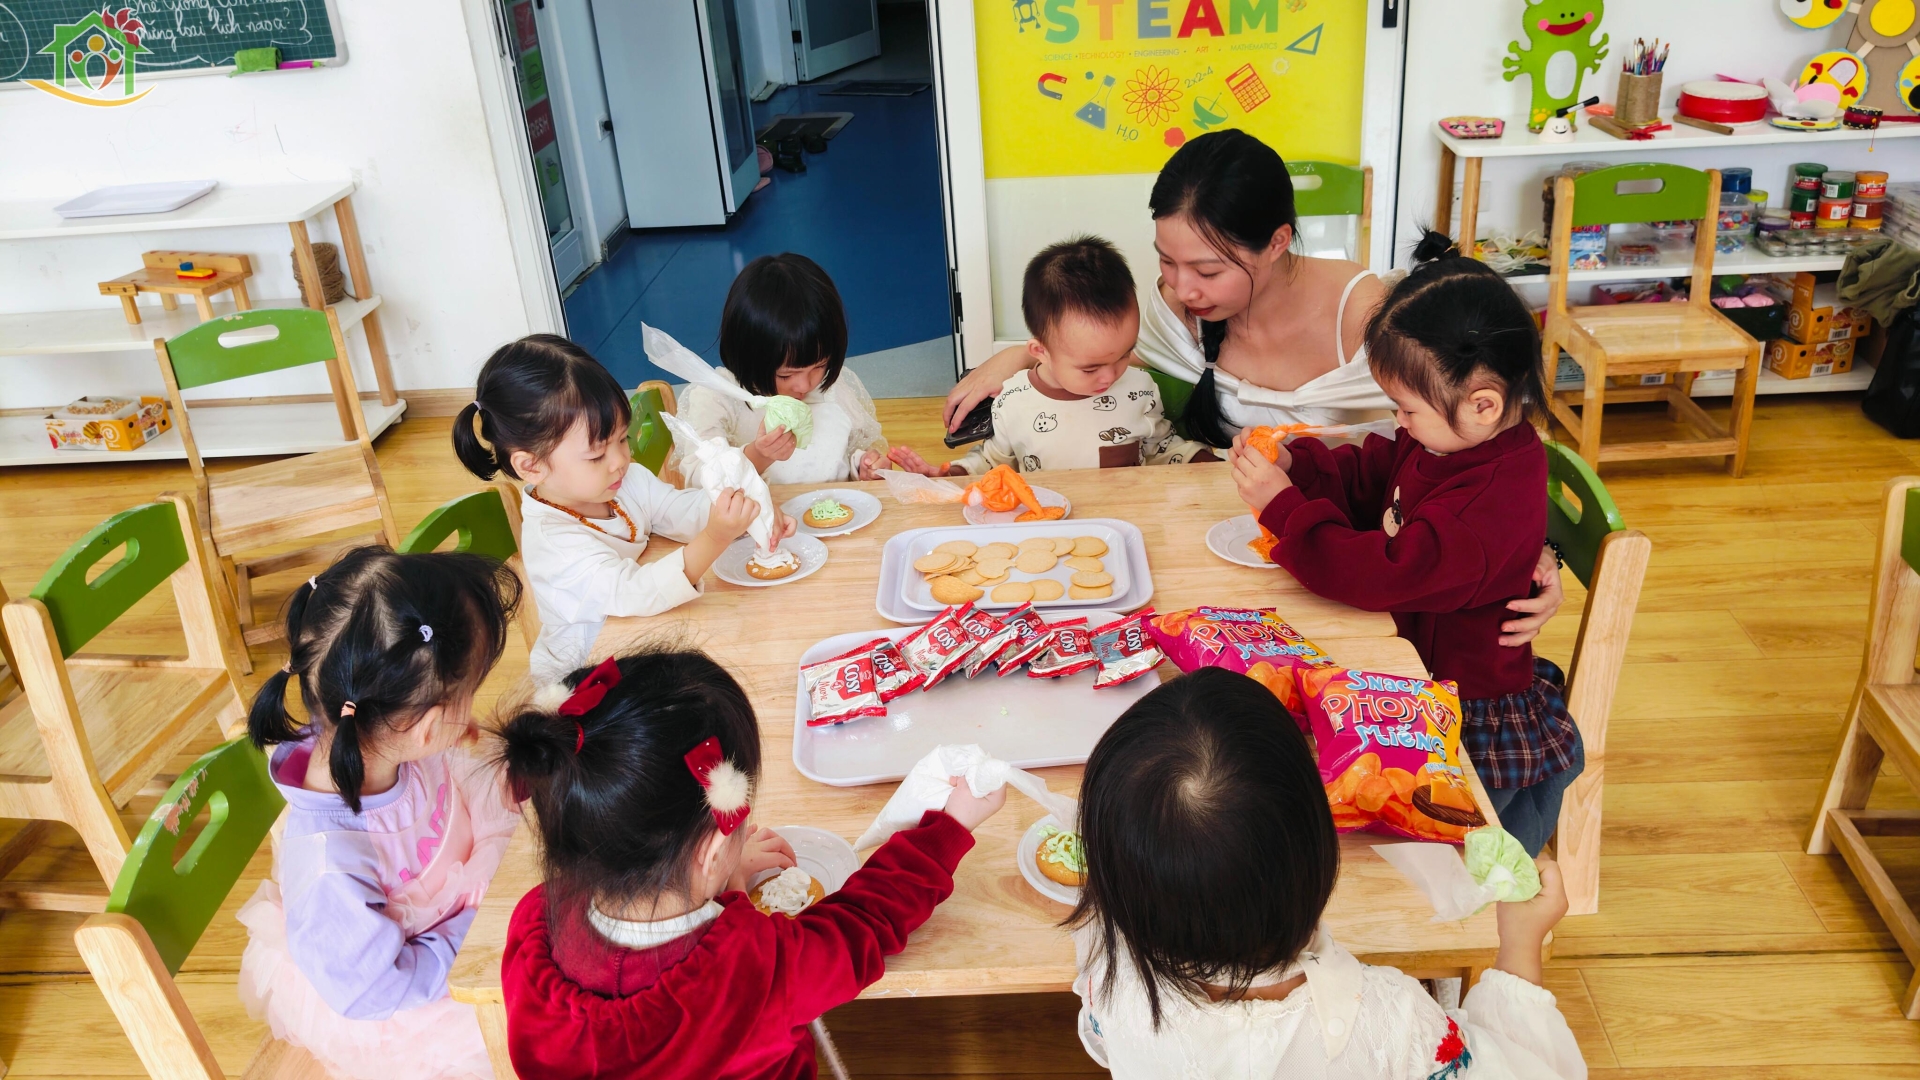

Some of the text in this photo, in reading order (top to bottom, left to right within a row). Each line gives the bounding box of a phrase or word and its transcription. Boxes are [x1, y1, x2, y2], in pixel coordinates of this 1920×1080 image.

[1044, 0, 1279, 44] STEAM
[1044, 53, 1073, 61] SCIENCE
[1078, 51, 1125, 60] TECHNOLOGY
[1134, 48, 1180, 57] ENGINEERING
[1230, 42, 1278, 51] MATHEMATICS
[933, 626, 959, 651] COSY
[963, 619, 995, 638] COSY
[1125, 627, 1143, 651] COSY
[1060, 630, 1078, 653] COSY
[873, 653, 898, 674] COSY
[844, 664, 862, 694] COSY
